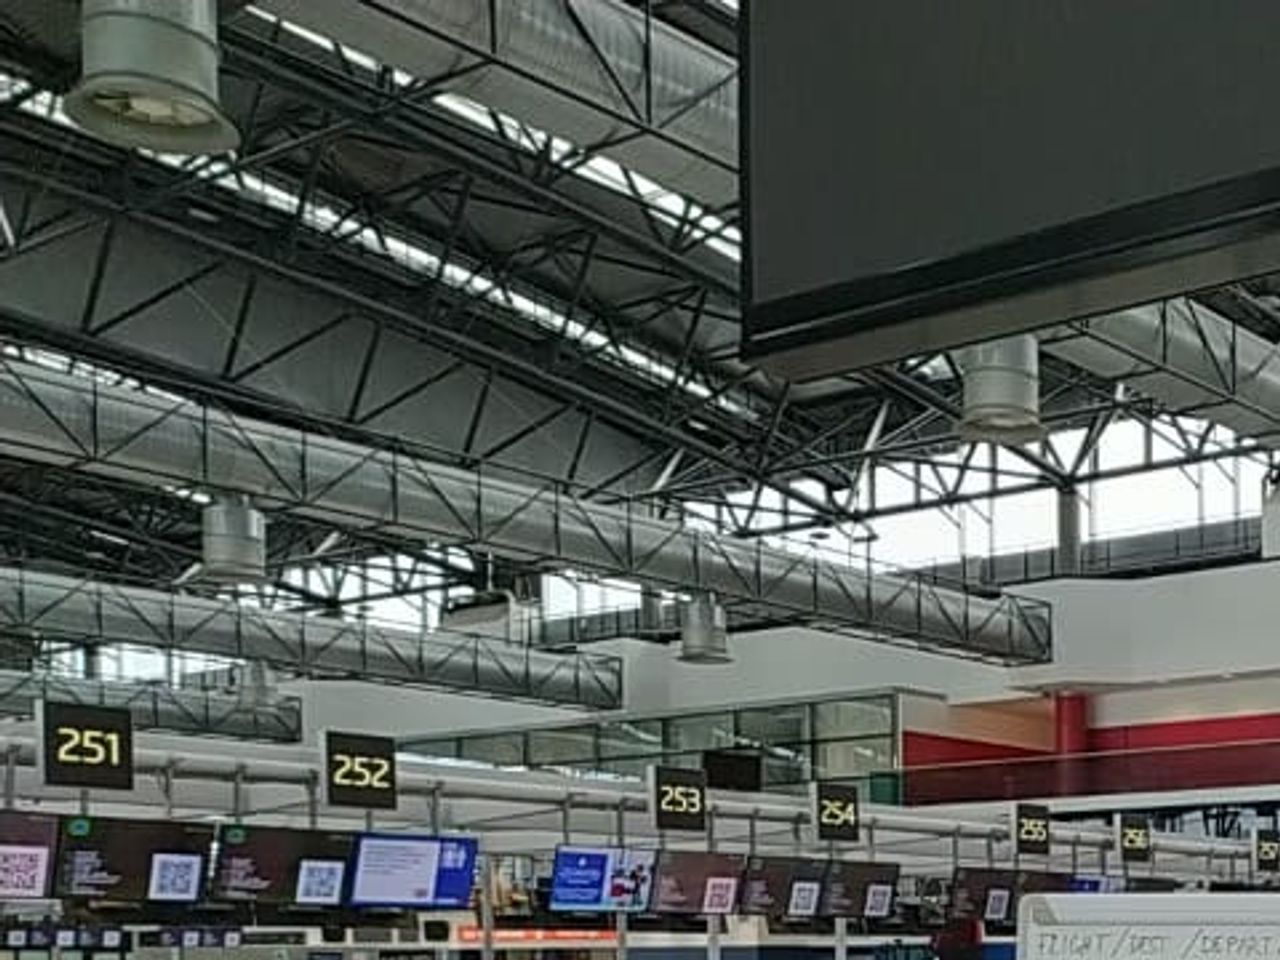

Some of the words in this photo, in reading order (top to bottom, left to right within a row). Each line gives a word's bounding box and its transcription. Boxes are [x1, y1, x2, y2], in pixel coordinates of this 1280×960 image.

[57, 727, 120, 766] 251
[333, 754, 391, 789] 252
[659, 785, 701, 814] 253
[820, 800, 855, 826] 254
[1020, 818, 1047, 841] 255
